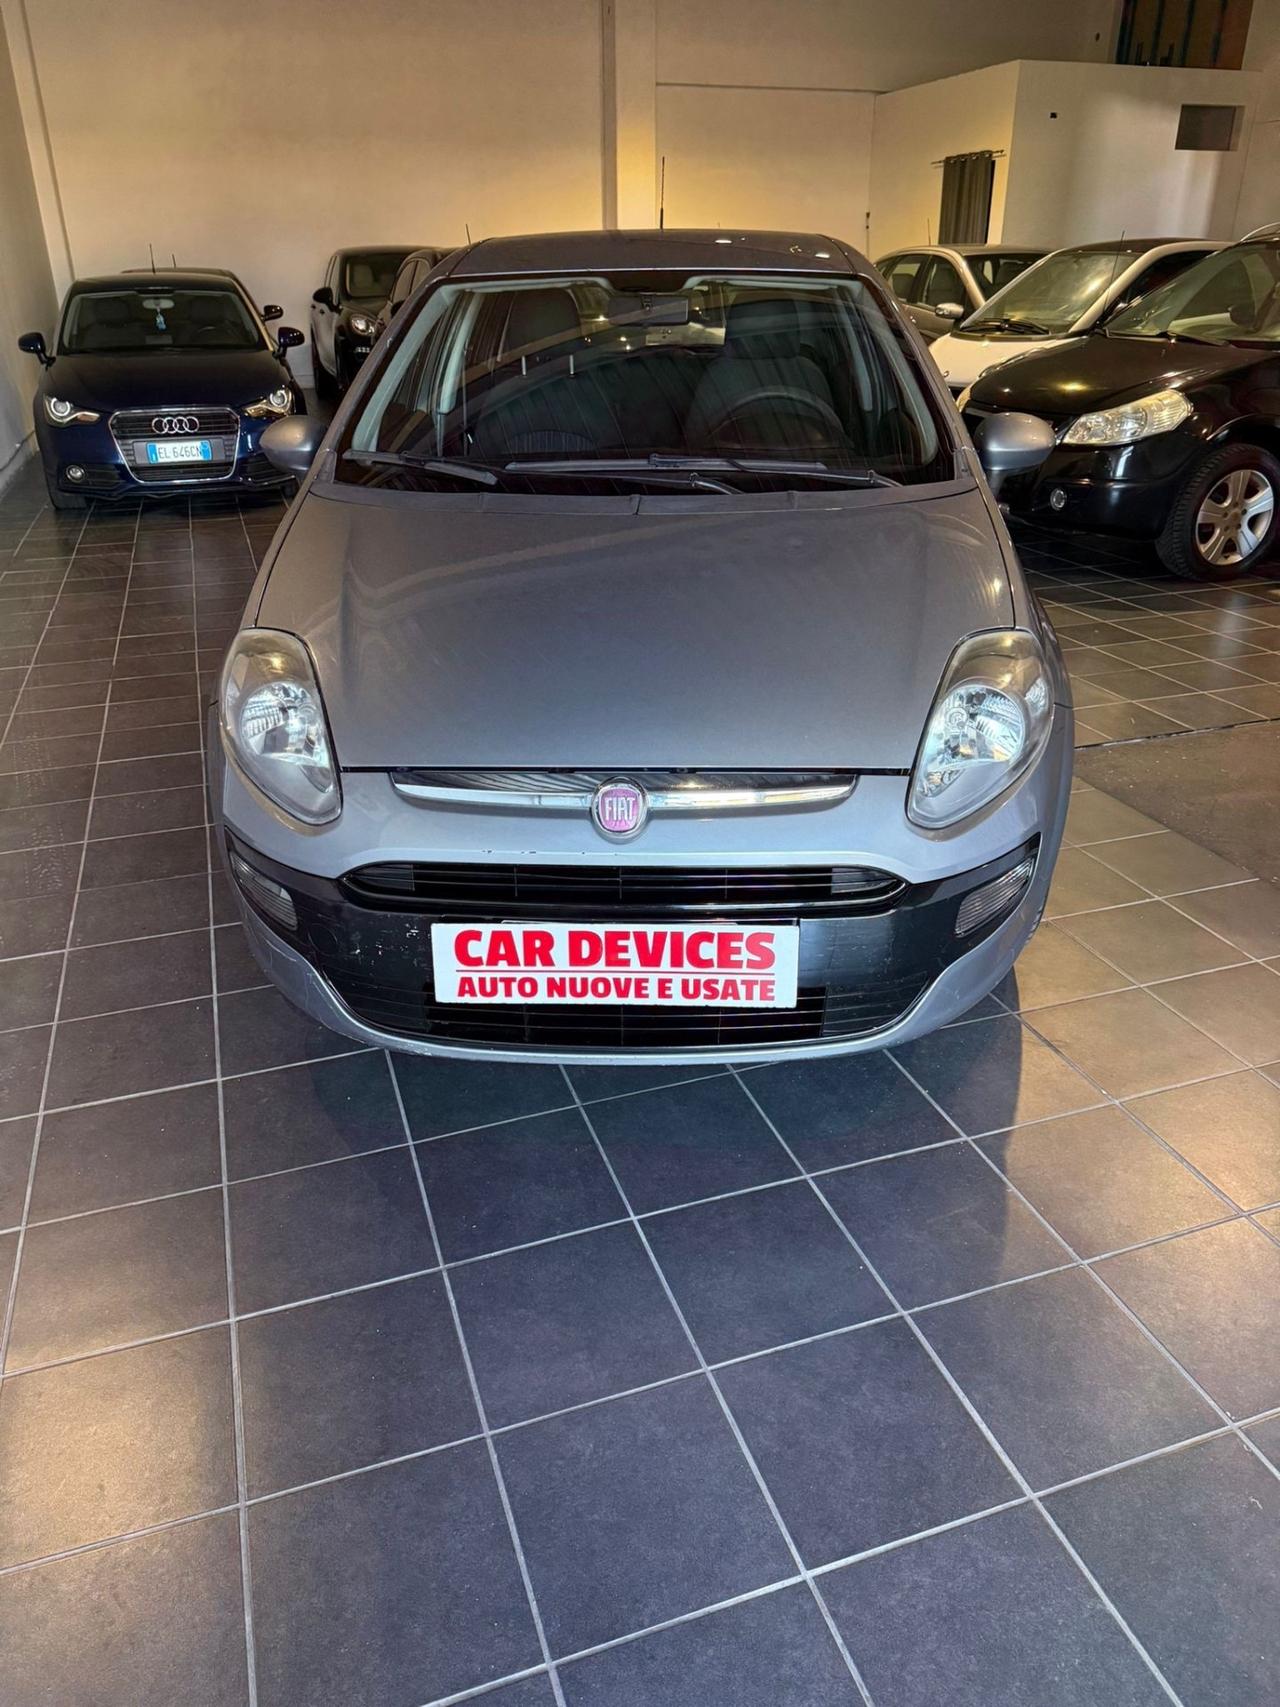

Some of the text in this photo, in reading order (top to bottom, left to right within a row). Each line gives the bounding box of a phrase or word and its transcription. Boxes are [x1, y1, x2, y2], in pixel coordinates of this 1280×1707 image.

[604, 796, 636, 821] FIAT
[454, 929, 775, 970] CAR DEVICES
[457, 976, 775, 1001] AUTO NUOVE E USATE
